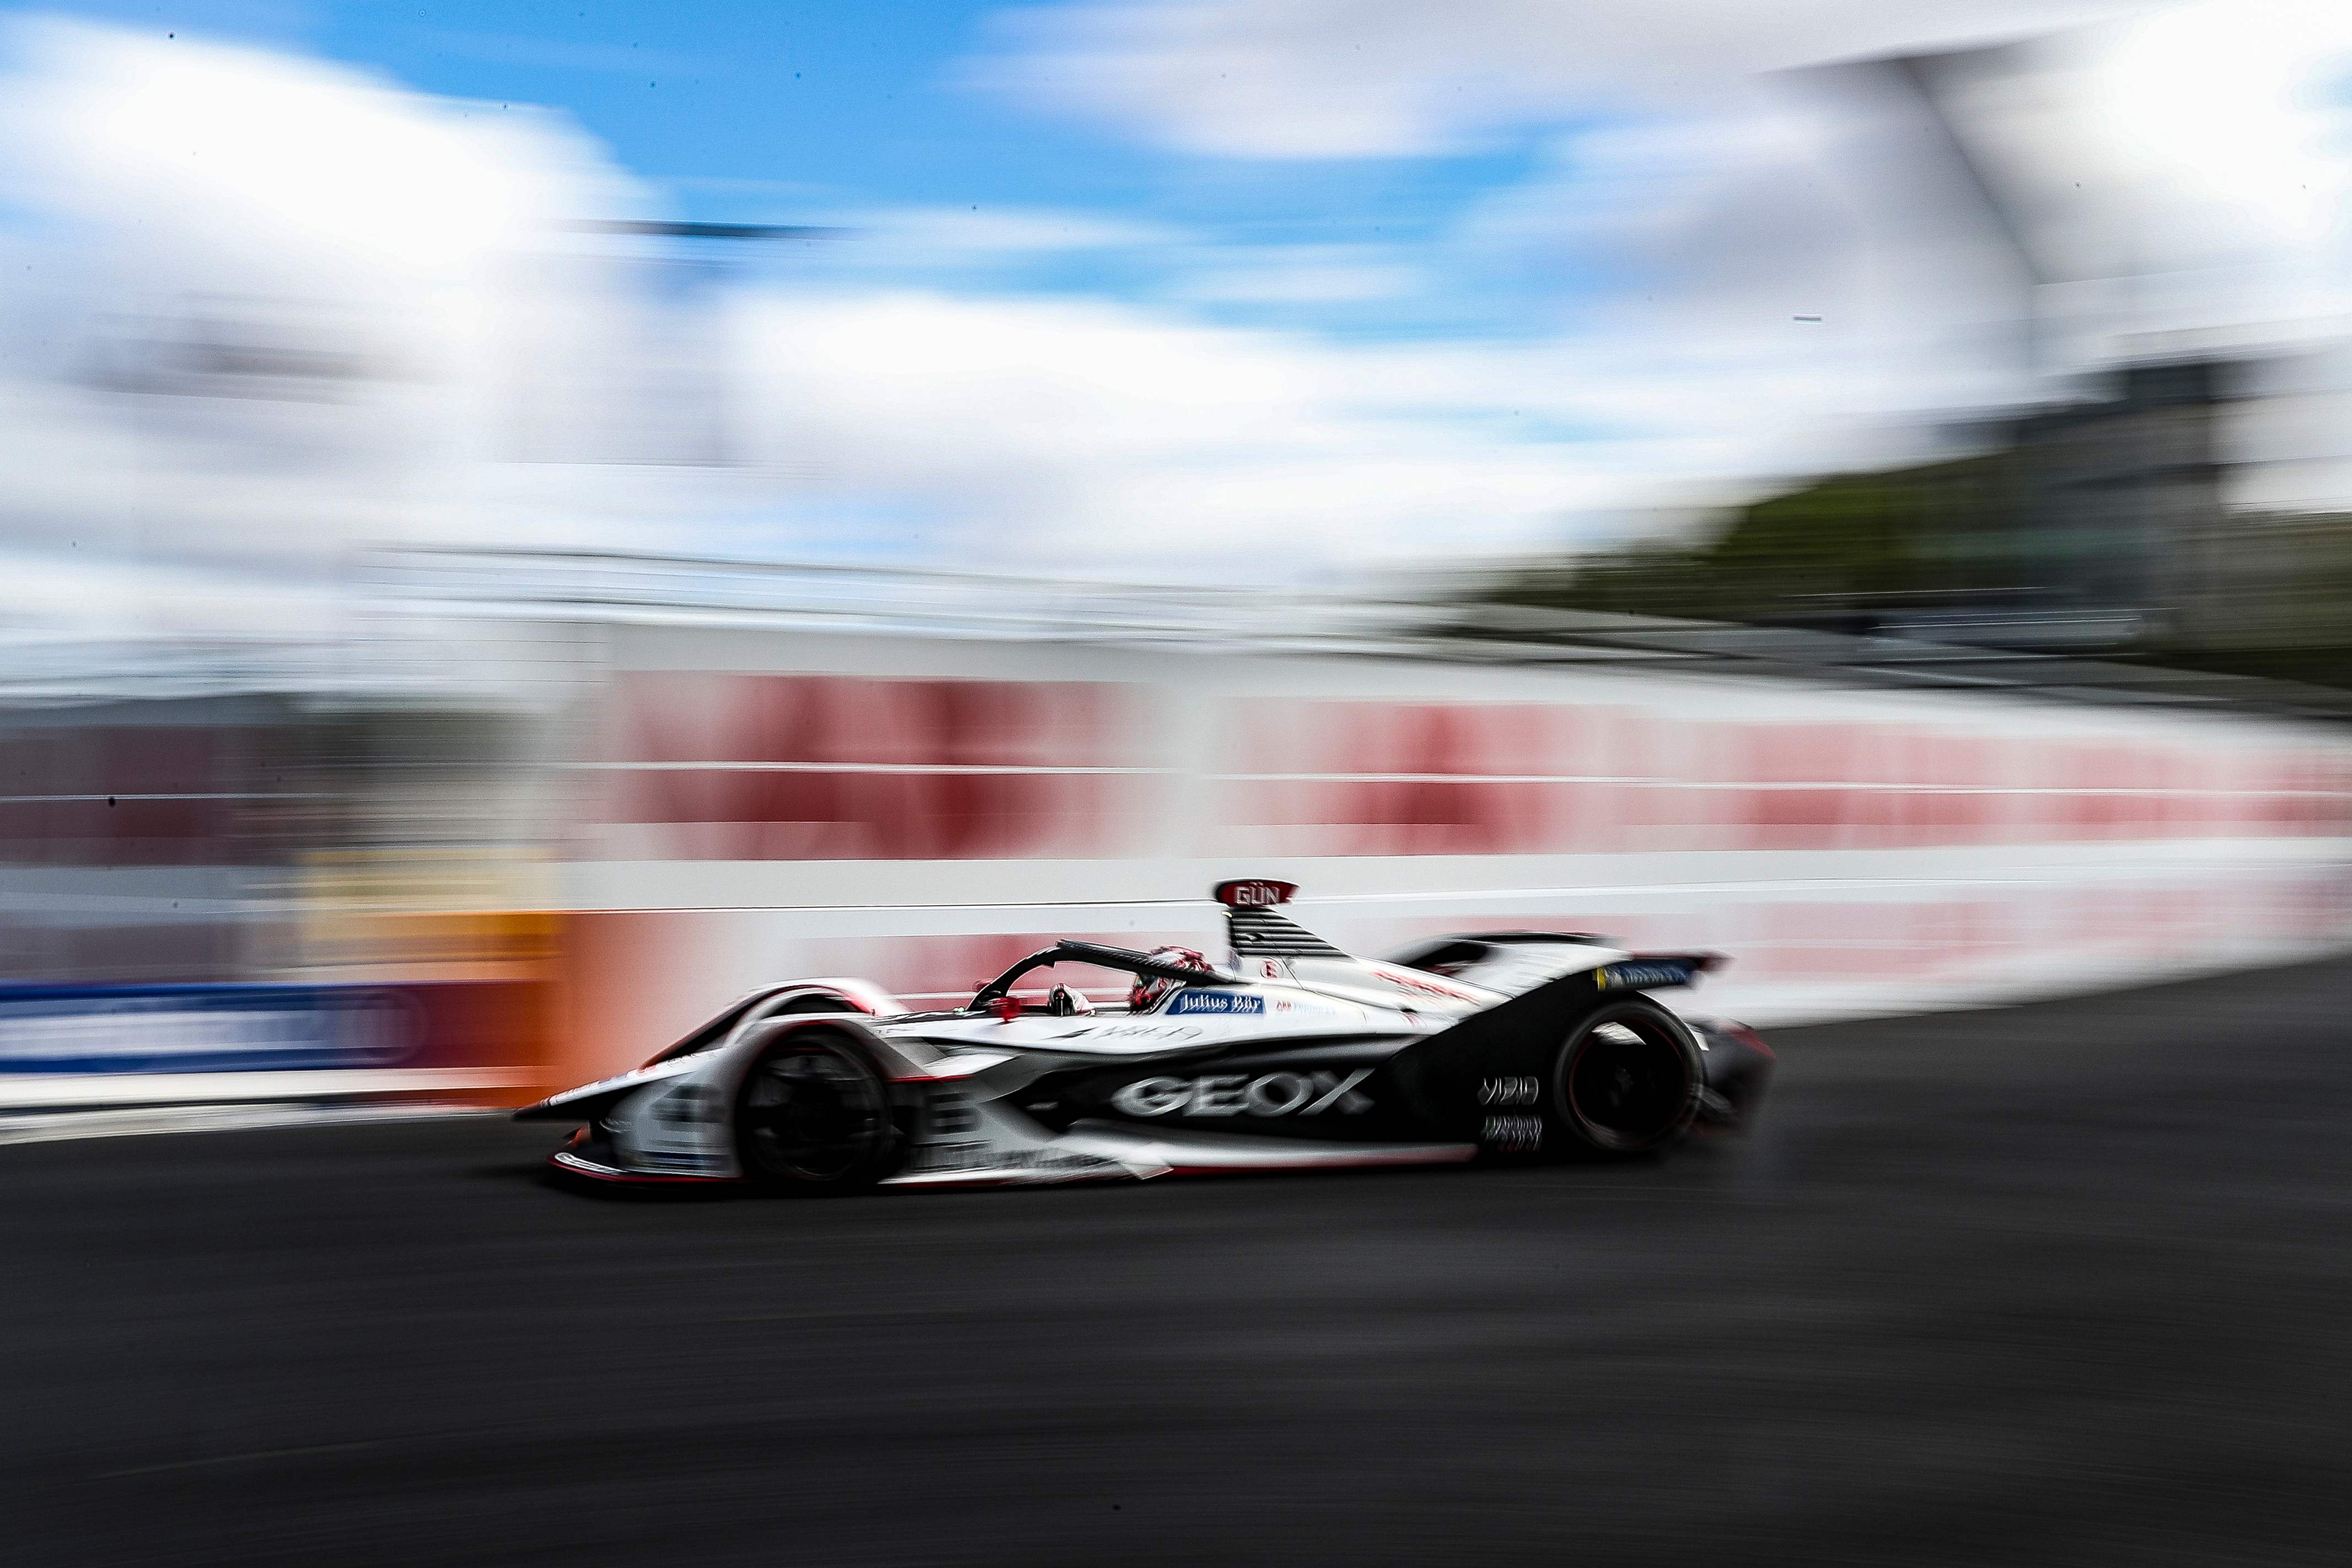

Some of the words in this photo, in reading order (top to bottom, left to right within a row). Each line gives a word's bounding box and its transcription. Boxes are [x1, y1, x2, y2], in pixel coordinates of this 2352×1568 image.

[1234, 882, 1280, 905] GÜN
[1179, 995, 1228, 1013] Julius
[1110, 1068, 1376, 1117] GEOX
